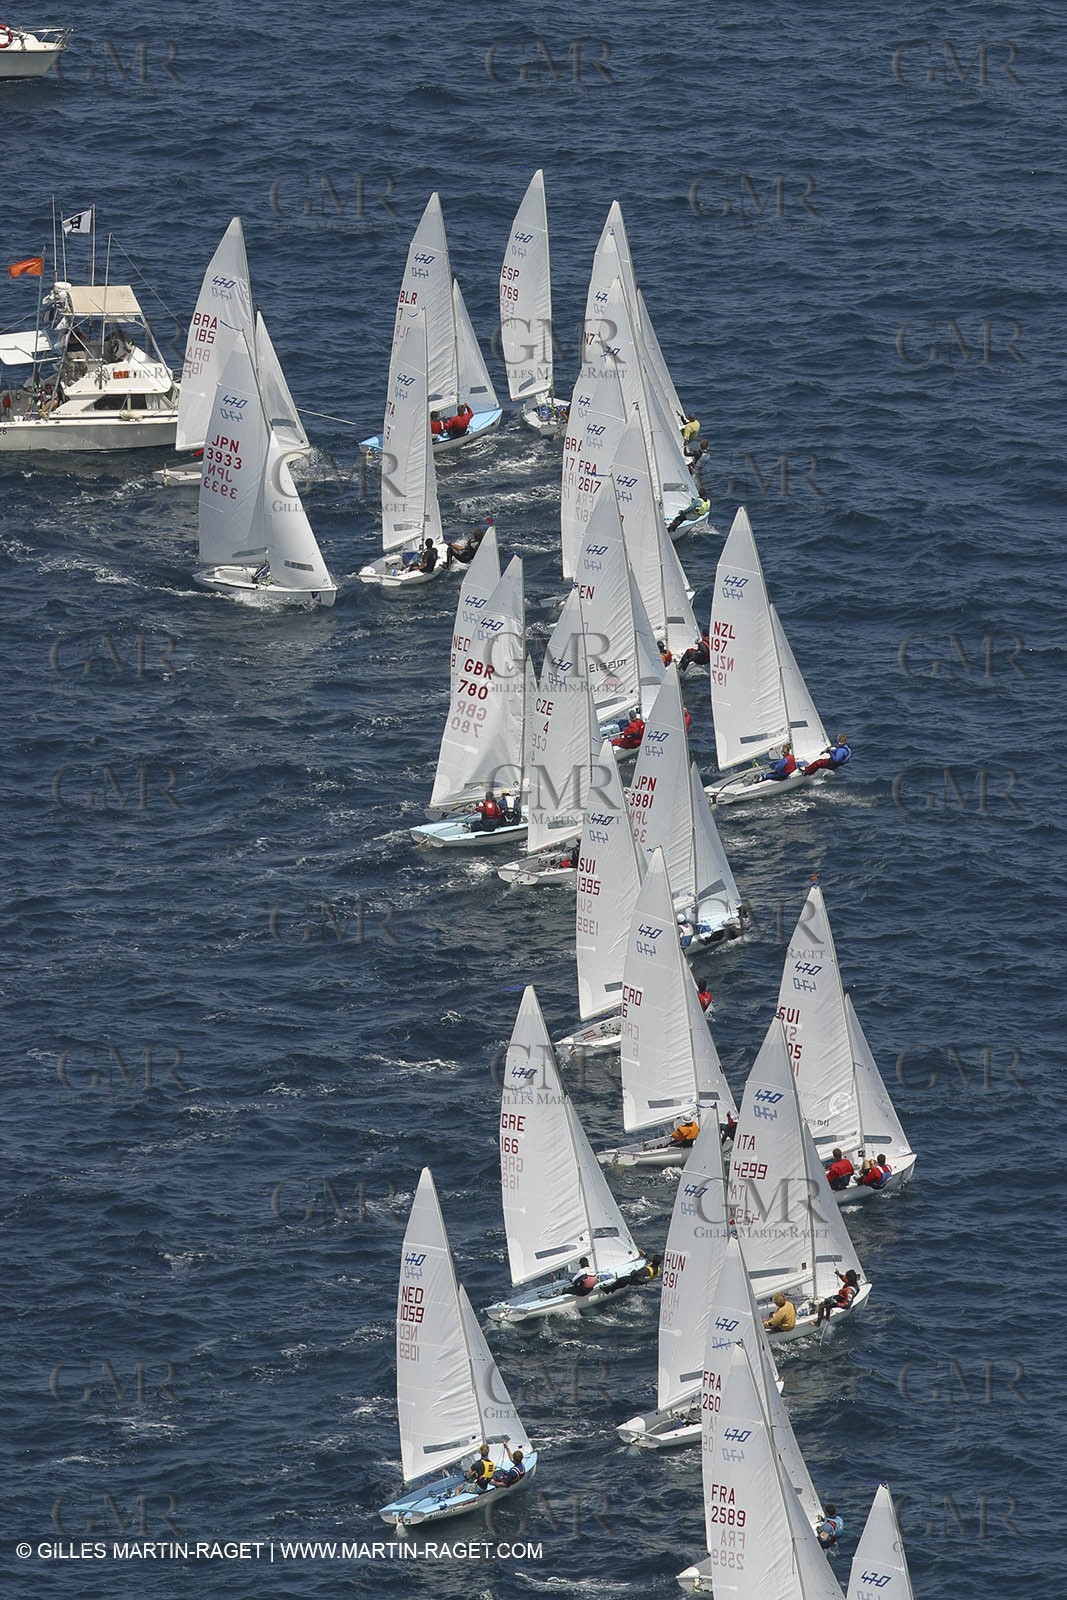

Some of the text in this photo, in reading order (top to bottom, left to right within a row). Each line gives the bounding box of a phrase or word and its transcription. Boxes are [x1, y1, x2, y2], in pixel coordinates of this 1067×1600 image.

[502, 265, 520, 280] ESP
[213, 276, 236, 288] 470
[400, 291, 417, 304] BLR
[595, 291, 608, 303] 47
[193, 313, 218, 330] BRA
[195, 328, 216, 344] 185
[222, 395, 248, 408] 470
[578, 395, 590, 407] 47
[586, 423, 606, 436] 470
[212, 435, 240, 453] JPN
[207, 448, 242, 469] 3933
[578, 460, 597, 477] FRA
[578, 476, 601, 494] 2617
[616, 475, 638, 488] 470
[724, 575, 748, 588] 470
[579, 585, 595, 599] EN
[465, 595, 487, 609] 470
[480, 617, 504, 631] 470
[714, 621, 735, 639] NZL
[711, 638, 727, 653] 197
[464, 658, 495, 680] GBR
[458, 679, 488, 700] 780
[536, 698, 554, 716] CZE
[543, 721, 549, 734] 4
[647, 730, 669, 742] 470
[634, 776, 657, 791] JPN
[630, 793, 654, 809] 3981
[591, 813, 615, 825] 470
[579, 857, 596, 874] SUI
[578, 876, 601, 896] 1395
[638, 924, 662, 939] 470
[795, 961, 822, 976] 470
[622, 985, 642, 1006] CRO
[779, 1006, 800, 1024] SUI
[512, 1066, 537, 1079] 470
[754, 1089, 784, 1104] 470
[501, 1113, 526, 1132] GRE
[501, 1136, 519, 1154] 166
[737, 1135, 755, 1150] ITA
[734, 1161, 768, 1180] 4299
[684, 1183, 709, 1198] 470
[405, 1252, 427, 1266] 470
[665, 1252, 686, 1271] HUN
[663, 1271, 678, 1288] 391
[401, 1286, 424, 1303] NED
[400, 1305, 424, 1323] 1059
[715, 1316, 739, 1331] 470
[702, 1371, 722, 1393] FRA
[702, 1393, 721, 1412] 260
[724, 1428, 752, 1442] 470
[711, 1483, 735, 1505] FRA
[711, 1506, 746, 1528] 2589
[861, 1570, 892, 1588] 470
